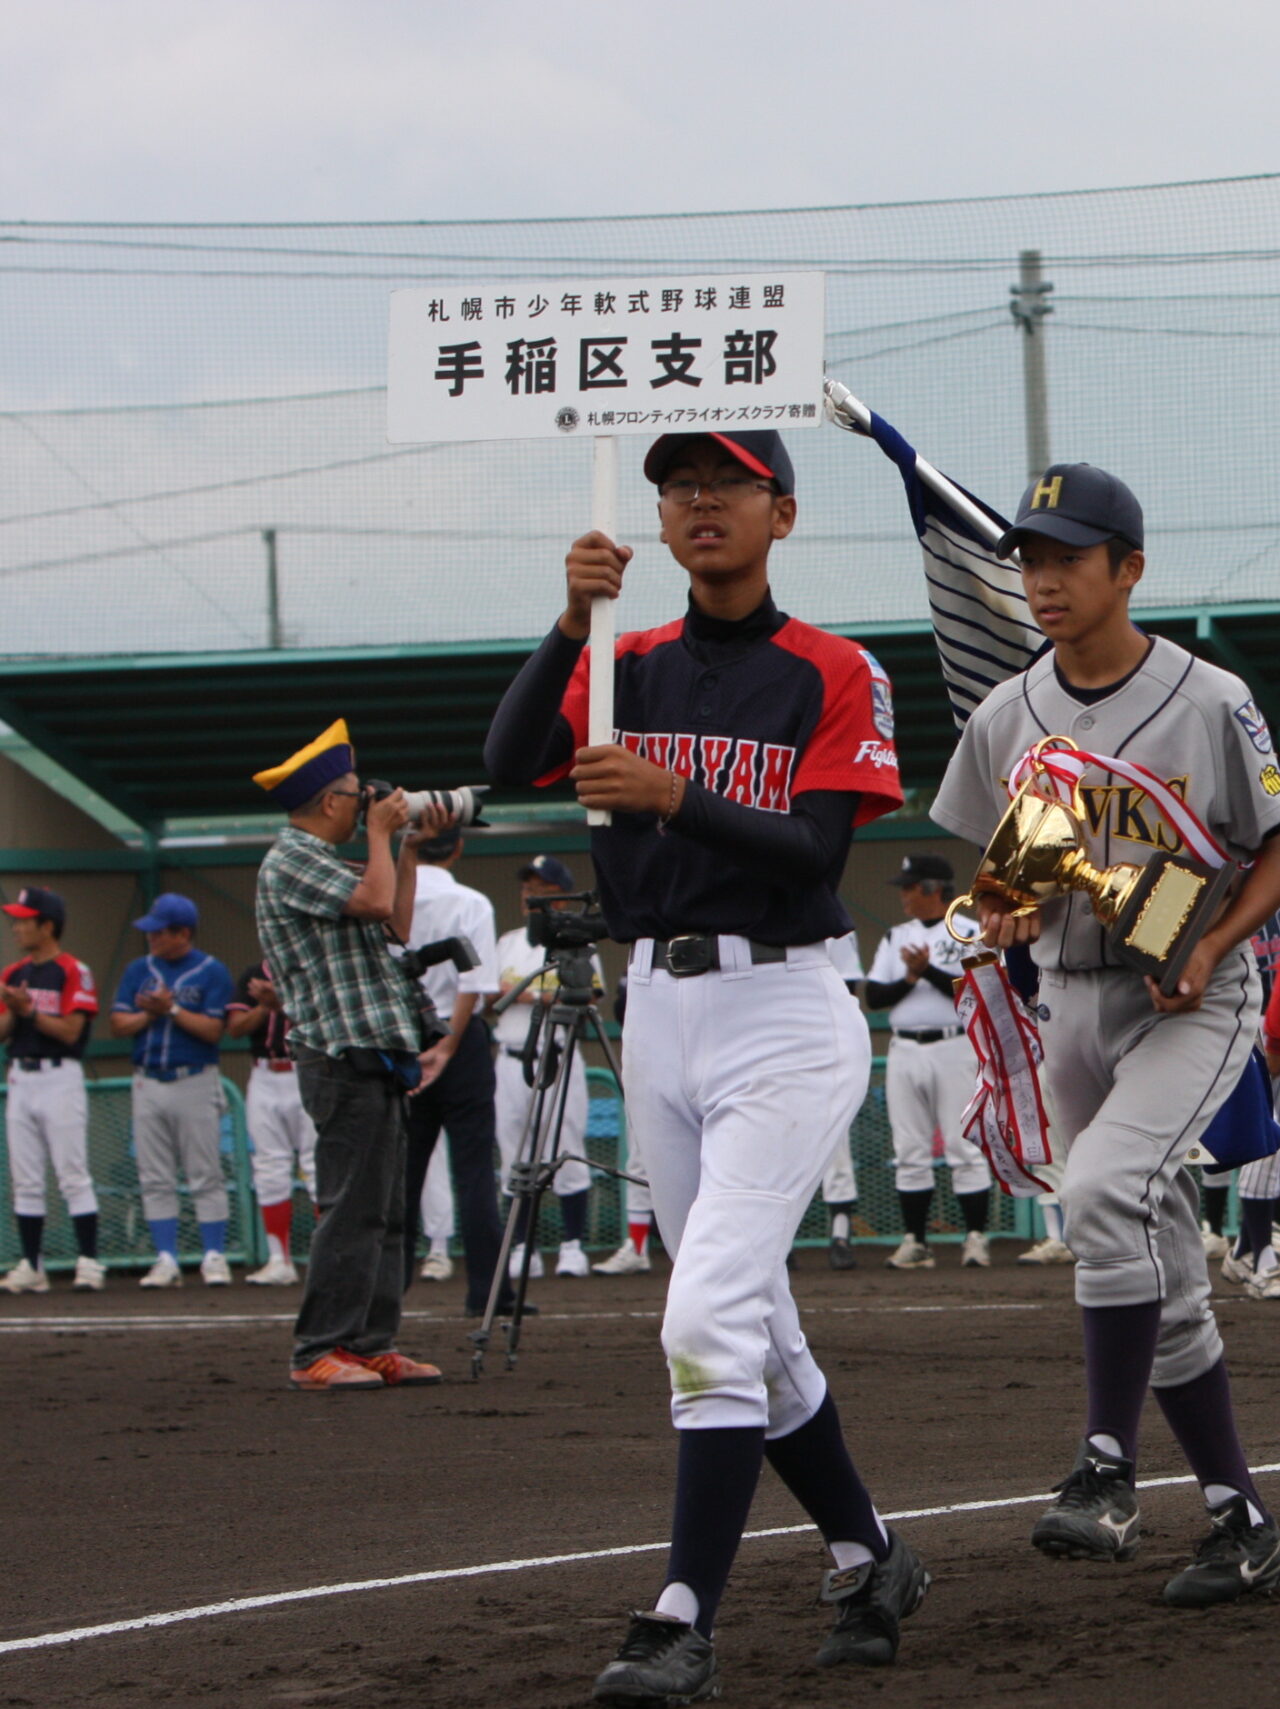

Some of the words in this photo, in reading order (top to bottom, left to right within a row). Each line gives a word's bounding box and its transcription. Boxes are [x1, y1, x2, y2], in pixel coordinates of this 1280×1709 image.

[428, 284, 785, 323] 札幌市少年軟式野球連盟
[434, 329, 778, 396] 手稲区支部
[587, 403, 817, 427] 札幌フロンティアライオンズクラブ寄贈
[1030, 475, 1064, 509] H
